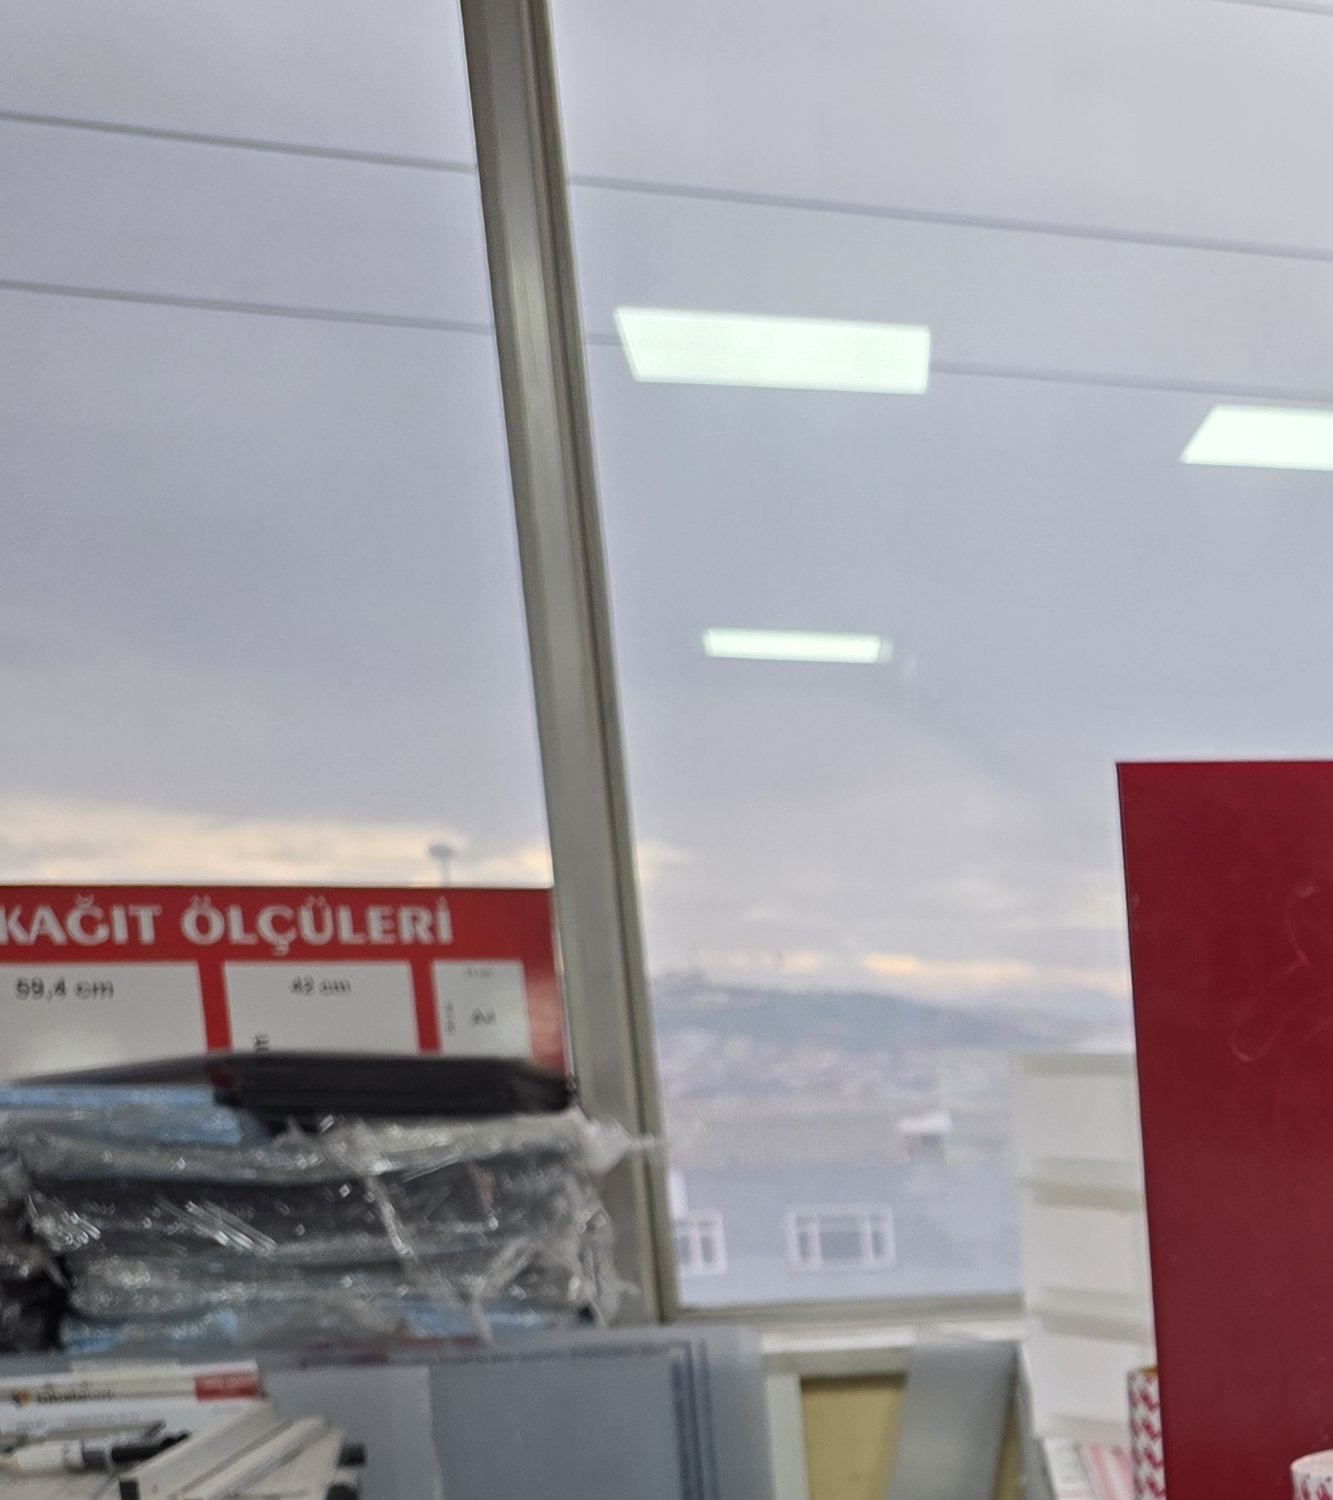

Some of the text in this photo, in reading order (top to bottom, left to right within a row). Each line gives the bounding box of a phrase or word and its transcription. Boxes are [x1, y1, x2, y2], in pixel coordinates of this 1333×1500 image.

[0, 892, 454, 956] KAĞIT ÖLÇÜLERİ
[14, 976, 115, 1002] 59,4 cm
